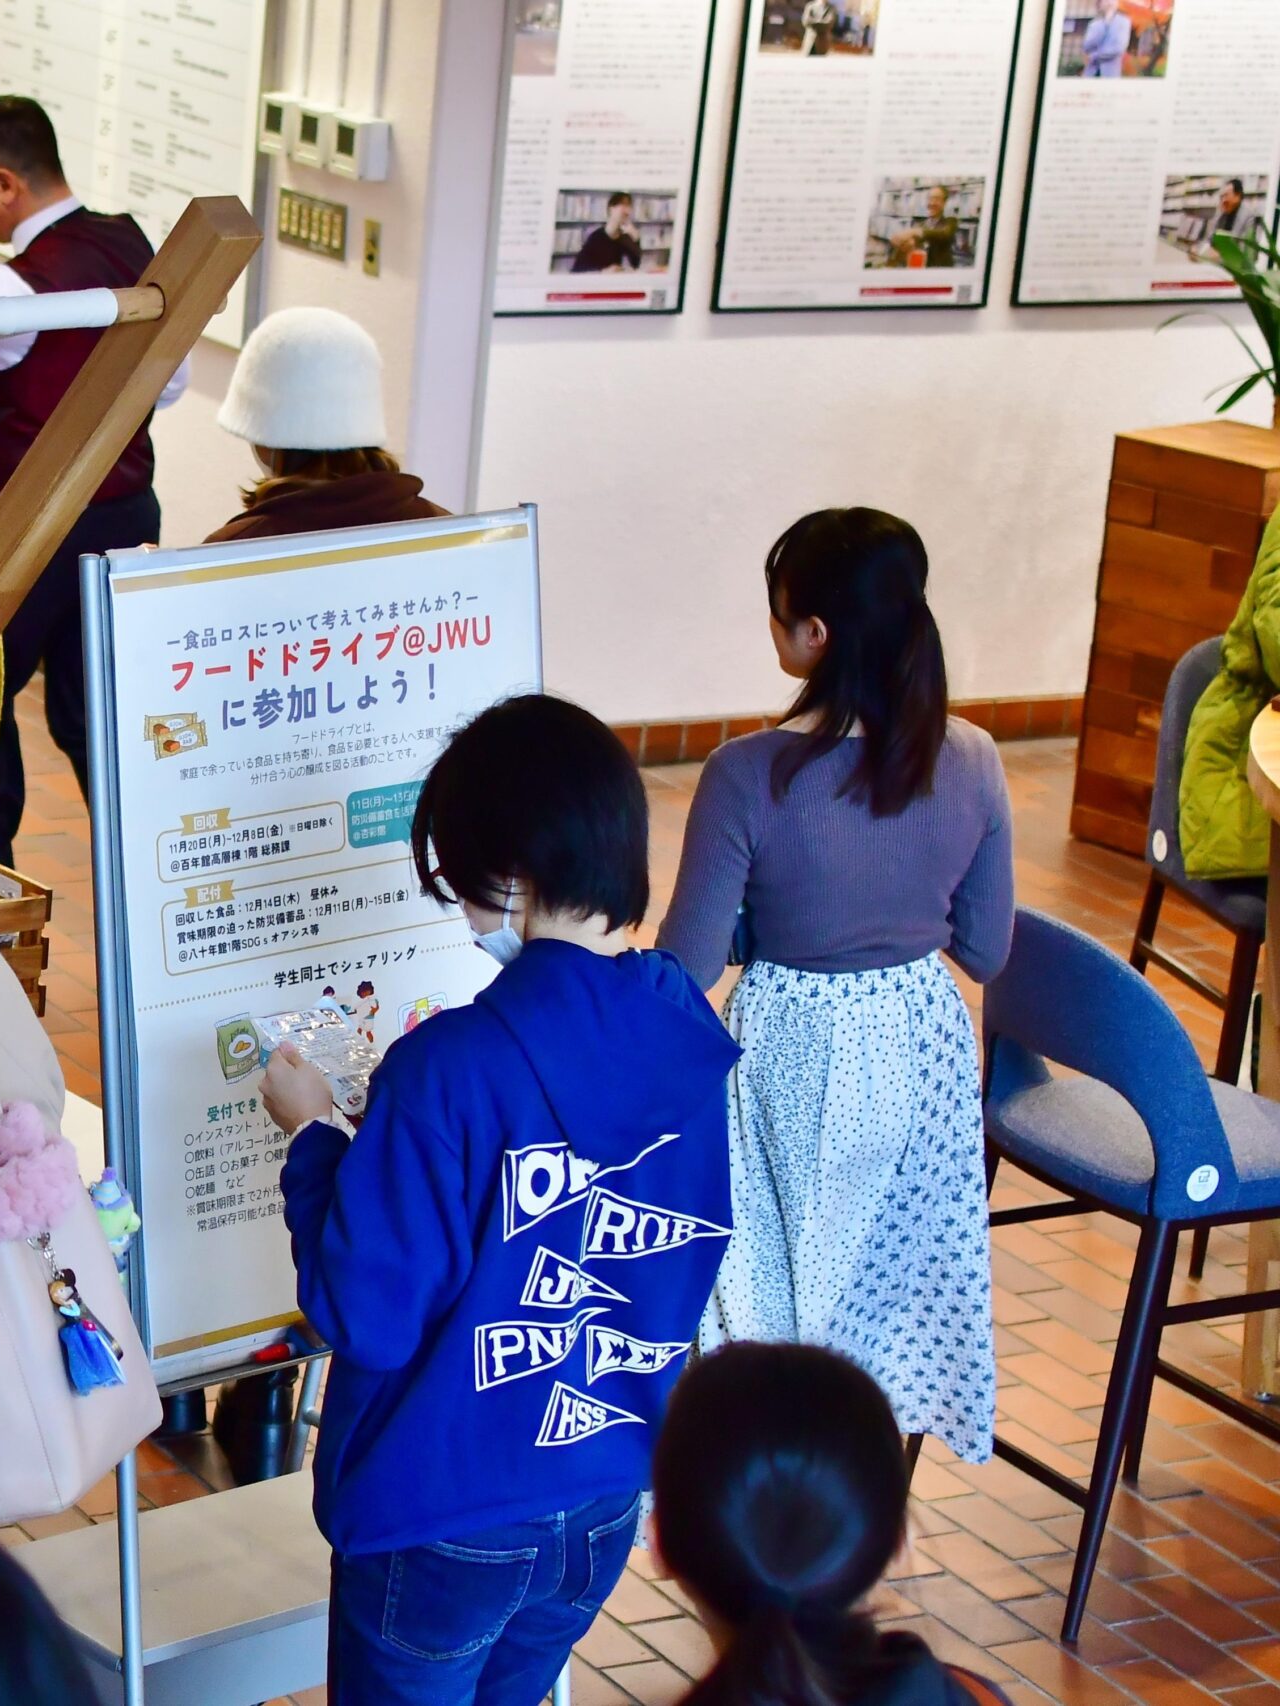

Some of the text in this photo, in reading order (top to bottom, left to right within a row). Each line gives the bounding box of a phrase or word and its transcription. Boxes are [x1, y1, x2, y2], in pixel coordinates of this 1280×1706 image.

[172, 615, 491, 692] フードドライブ@JWU
[222, 663, 437, 730] に参加しよう！
[193, 814, 218, 831] 回収
[261, 840, 291, 857] 総務課
[197, 885, 221, 903] 配付
[310, 885, 339, 900] 昼休み
[274, 945, 417, 989] 学生同士でシェアリング
[207, 1098, 258, 1124] 受付でき
[226, 1175, 246, 1190] など
[554, 1391, 607, 1439] HSS
